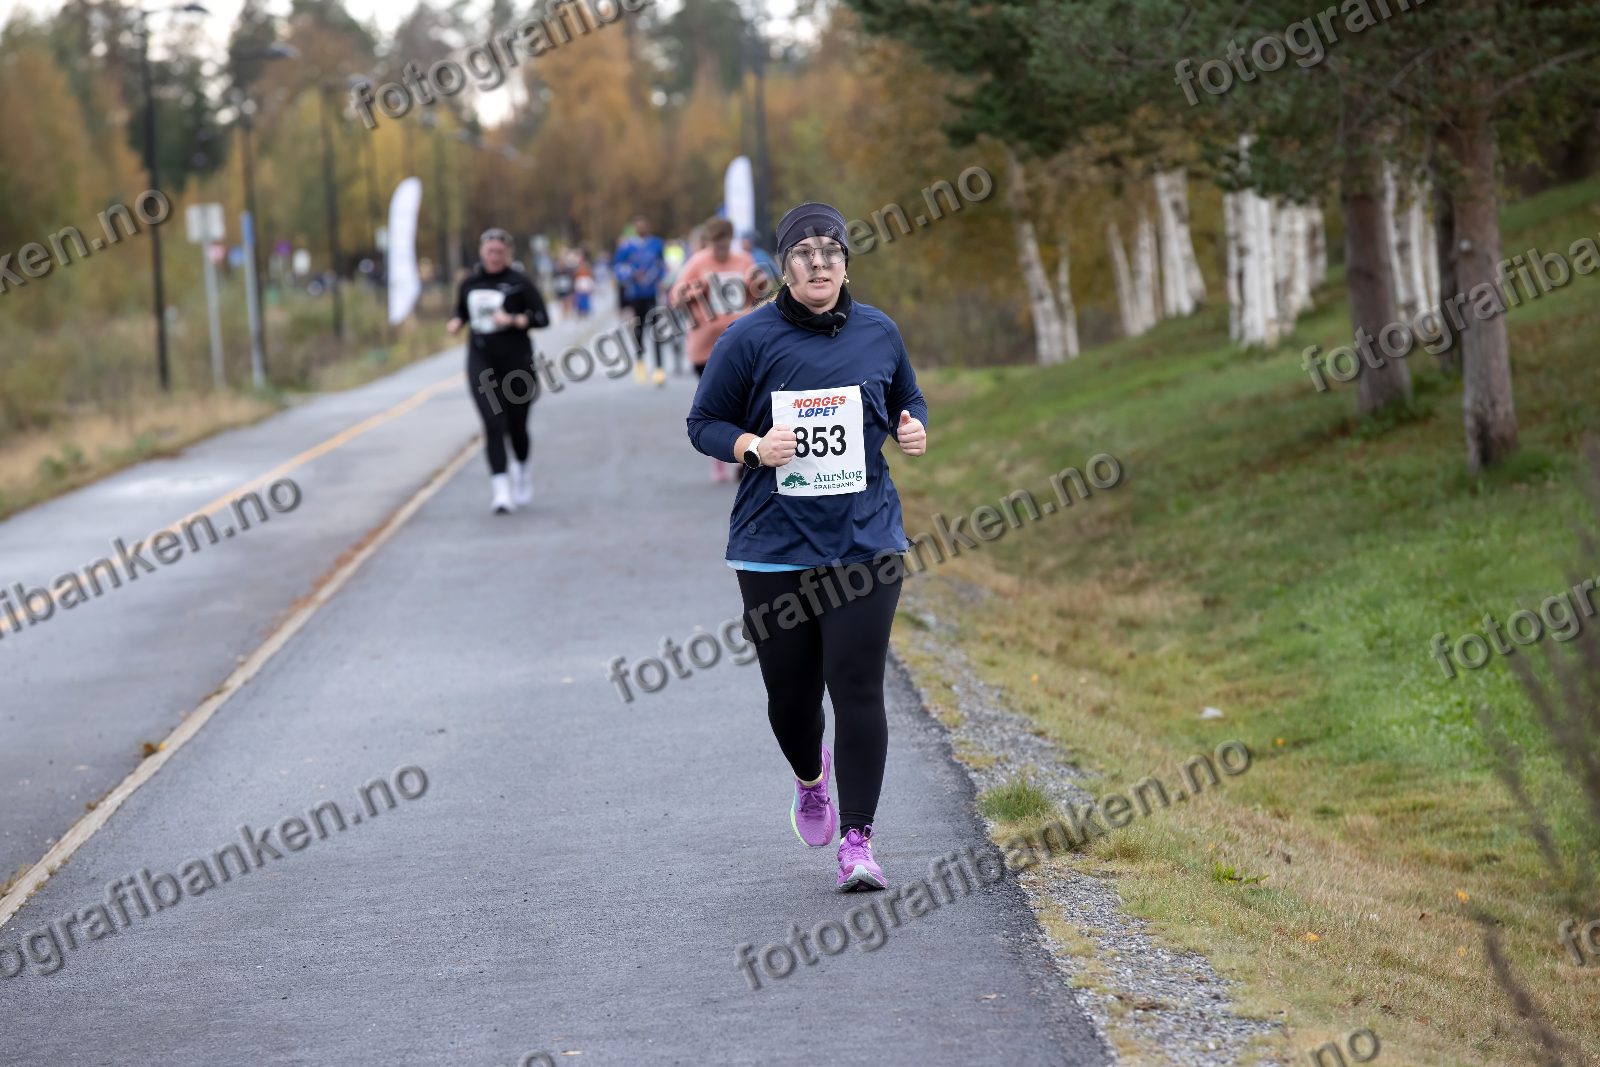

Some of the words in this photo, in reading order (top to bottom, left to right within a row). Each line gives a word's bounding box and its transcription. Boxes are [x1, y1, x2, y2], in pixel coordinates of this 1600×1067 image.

[793, 396, 846, 408] NORGES
[798, 406, 838, 418] LØPET
[793, 425, 846, 458] 853
[813, 470, 863, 482] Aurskog
